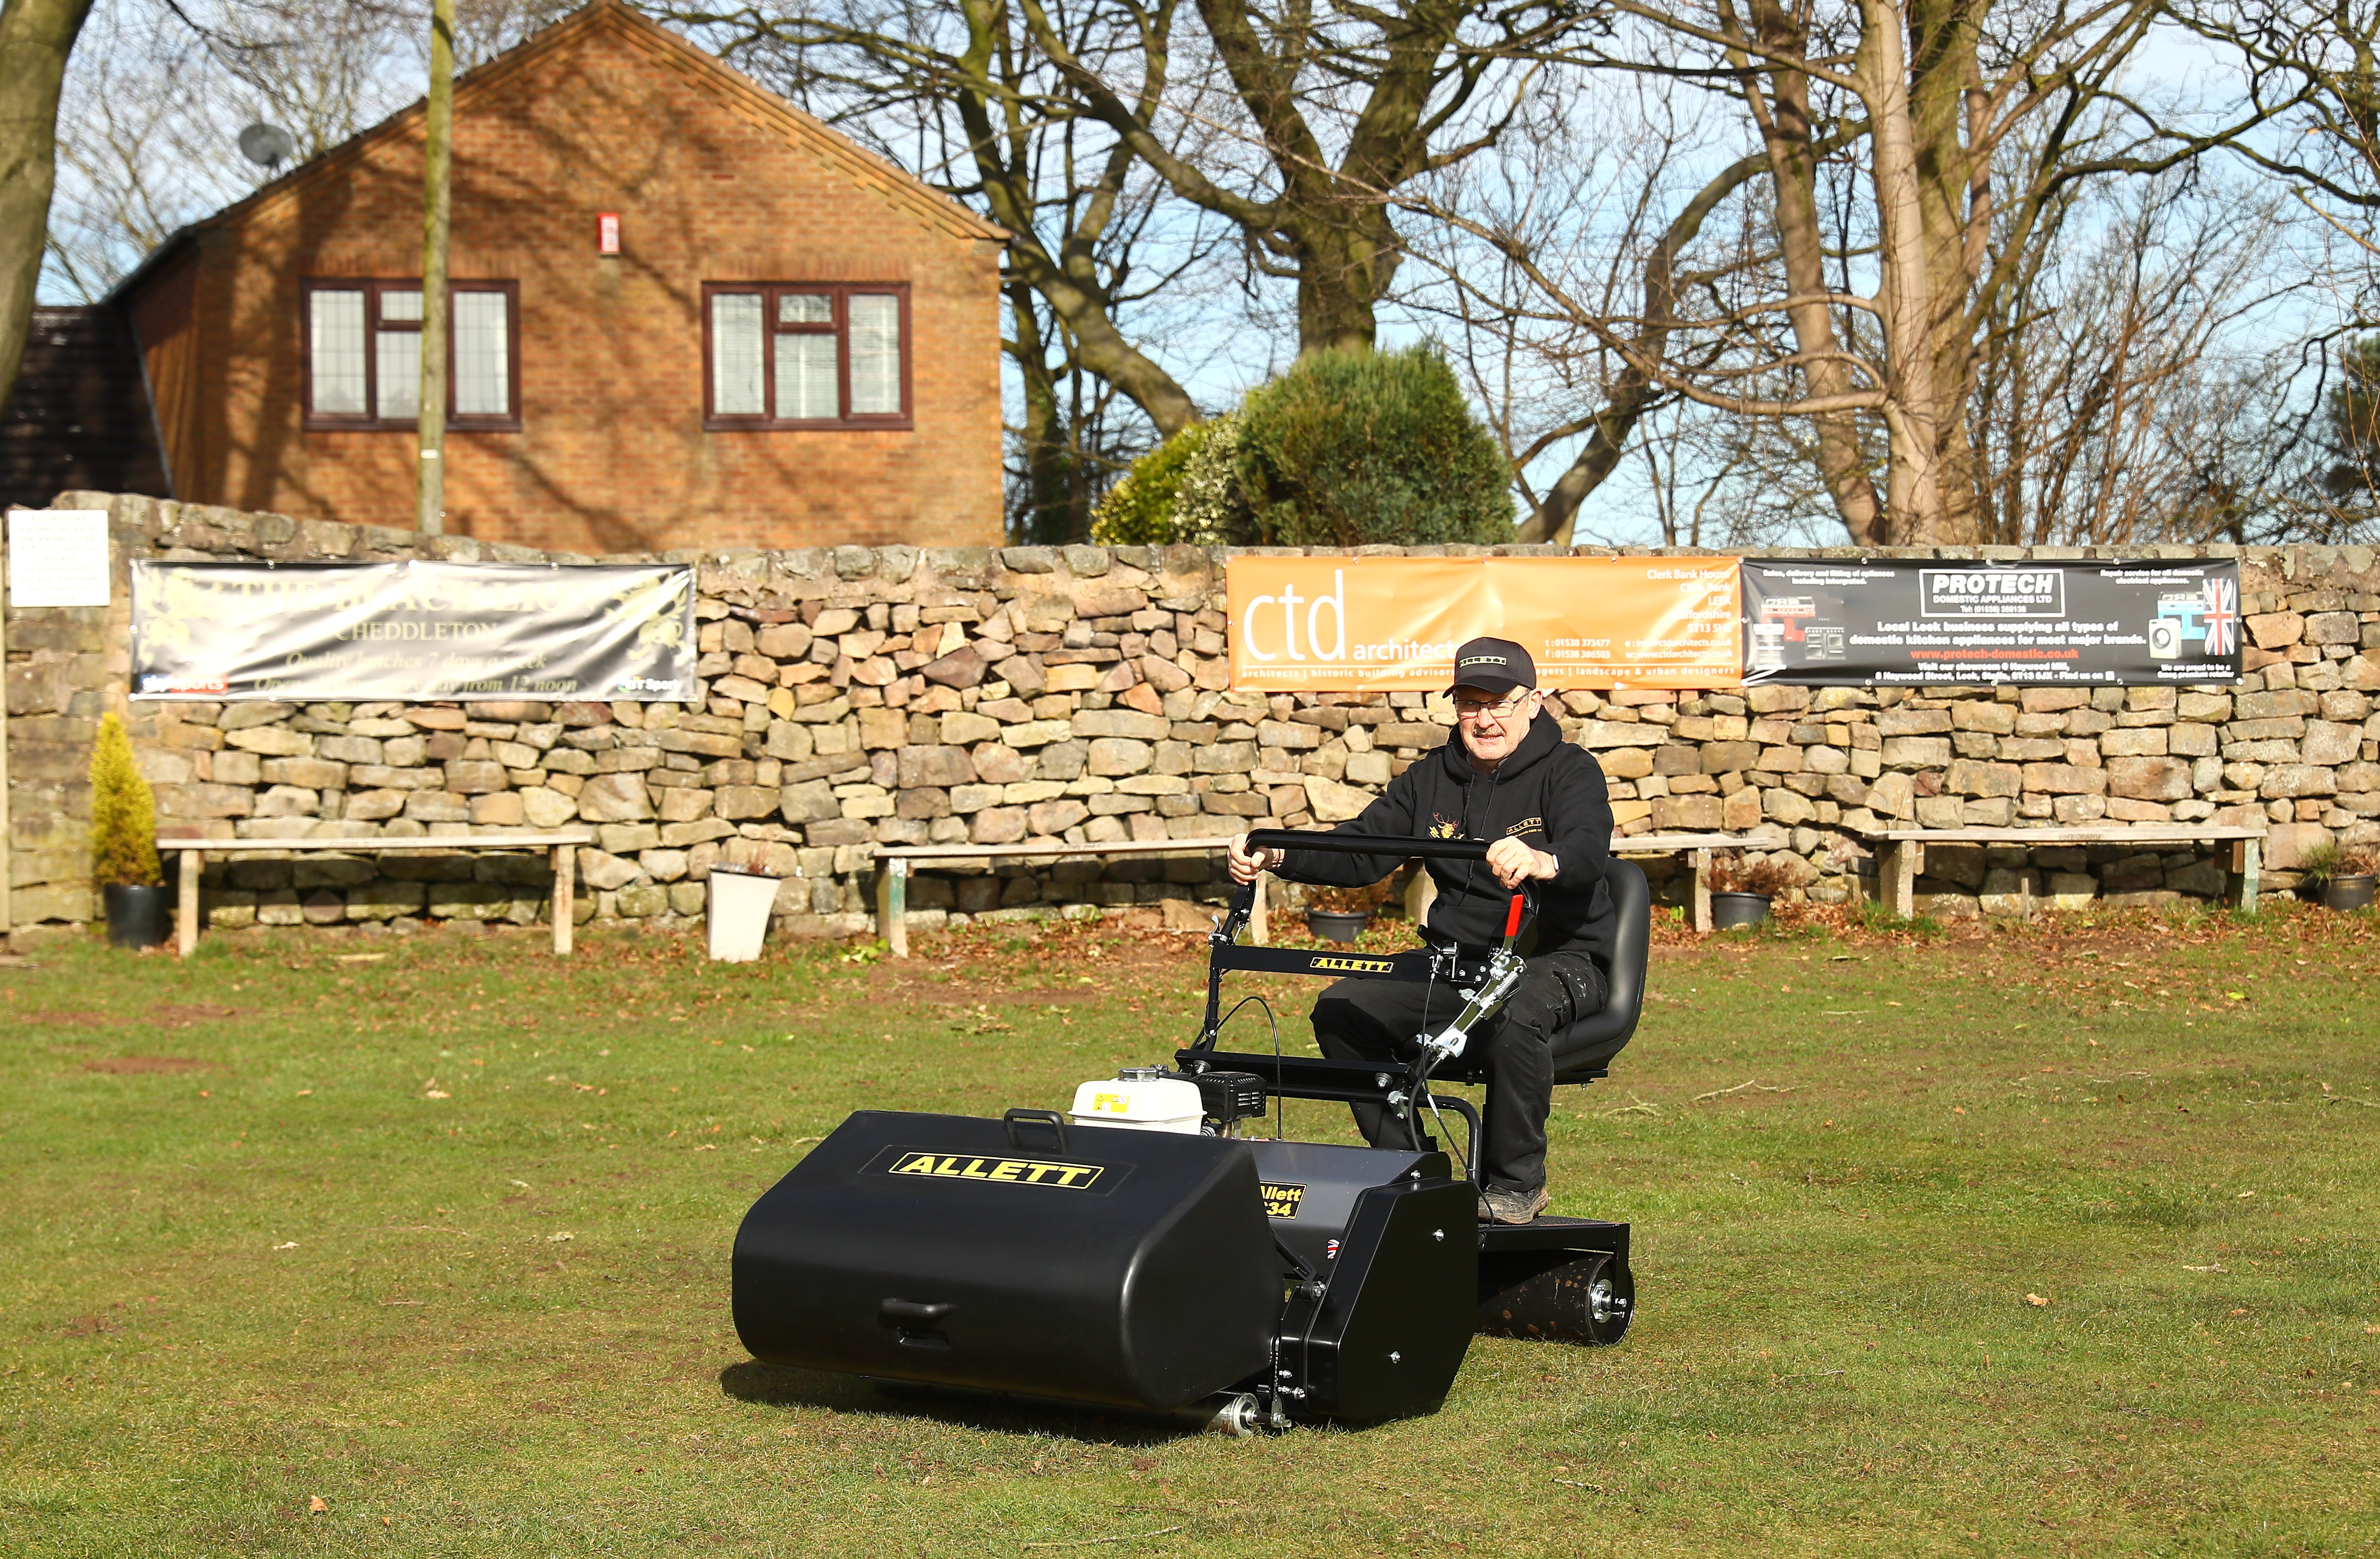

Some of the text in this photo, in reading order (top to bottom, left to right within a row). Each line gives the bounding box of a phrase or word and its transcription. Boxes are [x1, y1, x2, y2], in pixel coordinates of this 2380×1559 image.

[1647, 569, 1731, 579] Clerk Bank House
[1786, 569, 1815, 578] delivery
[1829, 570, 1851, 578] fitting
[2100, 569, 2123, 578] Repair
[1792, 577, 1824, 586] including
[1932, 574, 2054, 594] PROTECH
[2150, 577, 2190, 585] appliances.
[1679, 583, 1731, 593] Clerk Bank
[1708, 596, 1732, 605] LEEK
[1933, 594, 2053, 604] DOMESTIC APPLIANCES LTD
[1243, 569, 1346, 661] ctd
[334, 621, 500, 641] CHEDDLETON
[1687, 623, 1711, 633] ST13
[1877, 620, 2119, 634] Local Leek business supplying all types of
[1581, 638, 1611, 647] 373477
[1849, 634, 2147, 647] domestic kitchen appliances for most major brands.
[1580, 649, 1611, 659] 386503
[1910, 648, 2079, 660] www.protech-domestic.co.uk
[504, 652, 547, 669] eek
[1917, 662, 1938, 671] Visit
[1956, 662, 2001, 671] showroom
[2009, 661, 2050, 672] Haywood
[2051, 661, 2070, 672] Mill,
[2186, 663, 2206, 672] proud
[1242, 668, 1299, 678] architects
[1311, 668, 1354, 678] historic
[1358, 668, 1405, 678] building
[1409, 668, 1455, 677] advisors
[1576, 667, 1630, 677] landscape
[1635, 667, 1642, 676] &
[1646, 667, 1676, 676] urban
[1681, 666, 1735, 676] designers
[1883, 671, 1924, 681] Haywood
[1924, 671, 1955, 681] Street,
[1956, 671, 1980, 681] Leek,
[1981, 671, 2010, 681] Staffs,
[2011, 671, 2034, 680] ST13
[2059, 671, 2078, 680] Find
[2079, 672, 2091, 680] us
[2091, 672, 2103, 680] on
[2157, 671, 2177, 679] Smeg
[462, 677, 503, 694] from
[510, 675, 530, 692] 12
[533, 679, 578, 693] noon
[1509, 819, 1539, 833] ALLETT
[1315, 958, 1388, 972] ALLETT
[899, 1156, 1091, 1185] ALLETT
